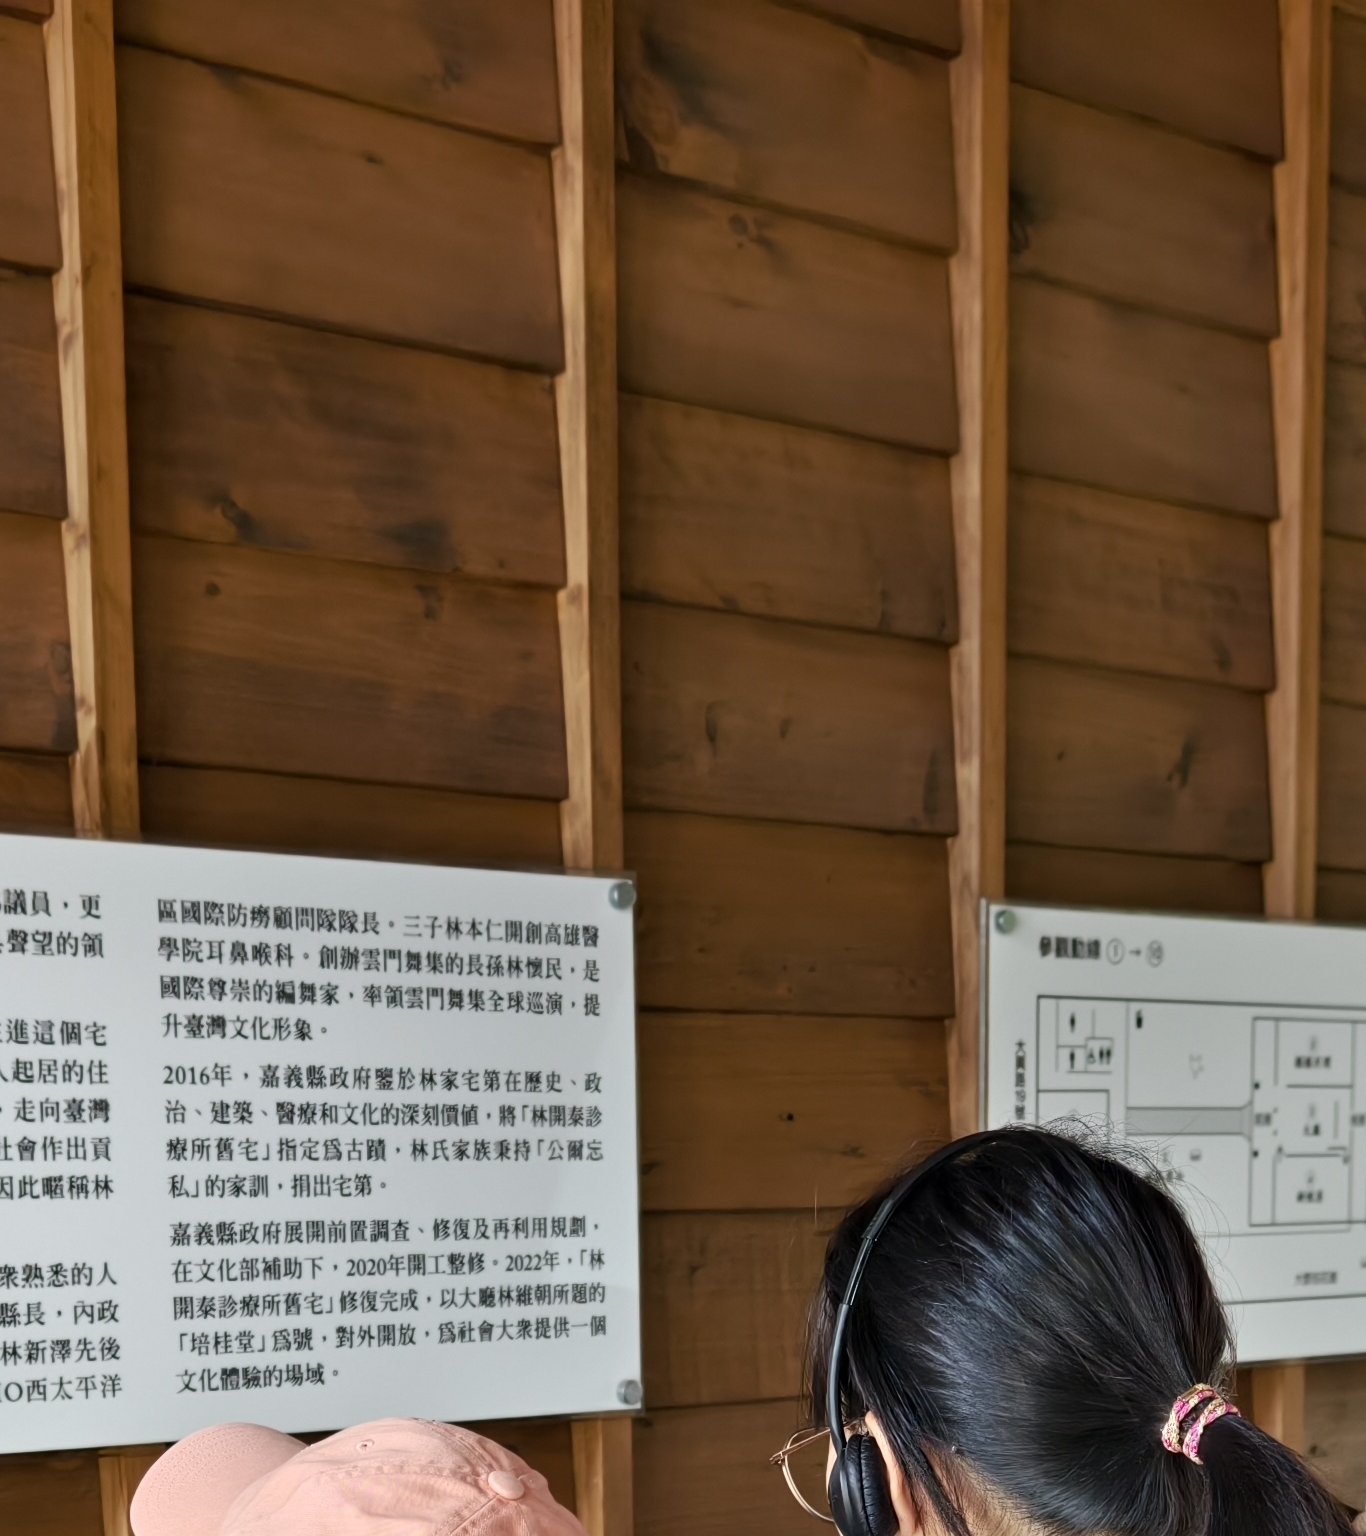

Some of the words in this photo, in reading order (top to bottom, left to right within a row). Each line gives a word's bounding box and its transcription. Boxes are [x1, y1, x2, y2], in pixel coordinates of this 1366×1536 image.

[163, 1013, 326, 1041] 升臺灣文化形象。
[177, 1363, 338, 1393] 文化體驗的場域。
